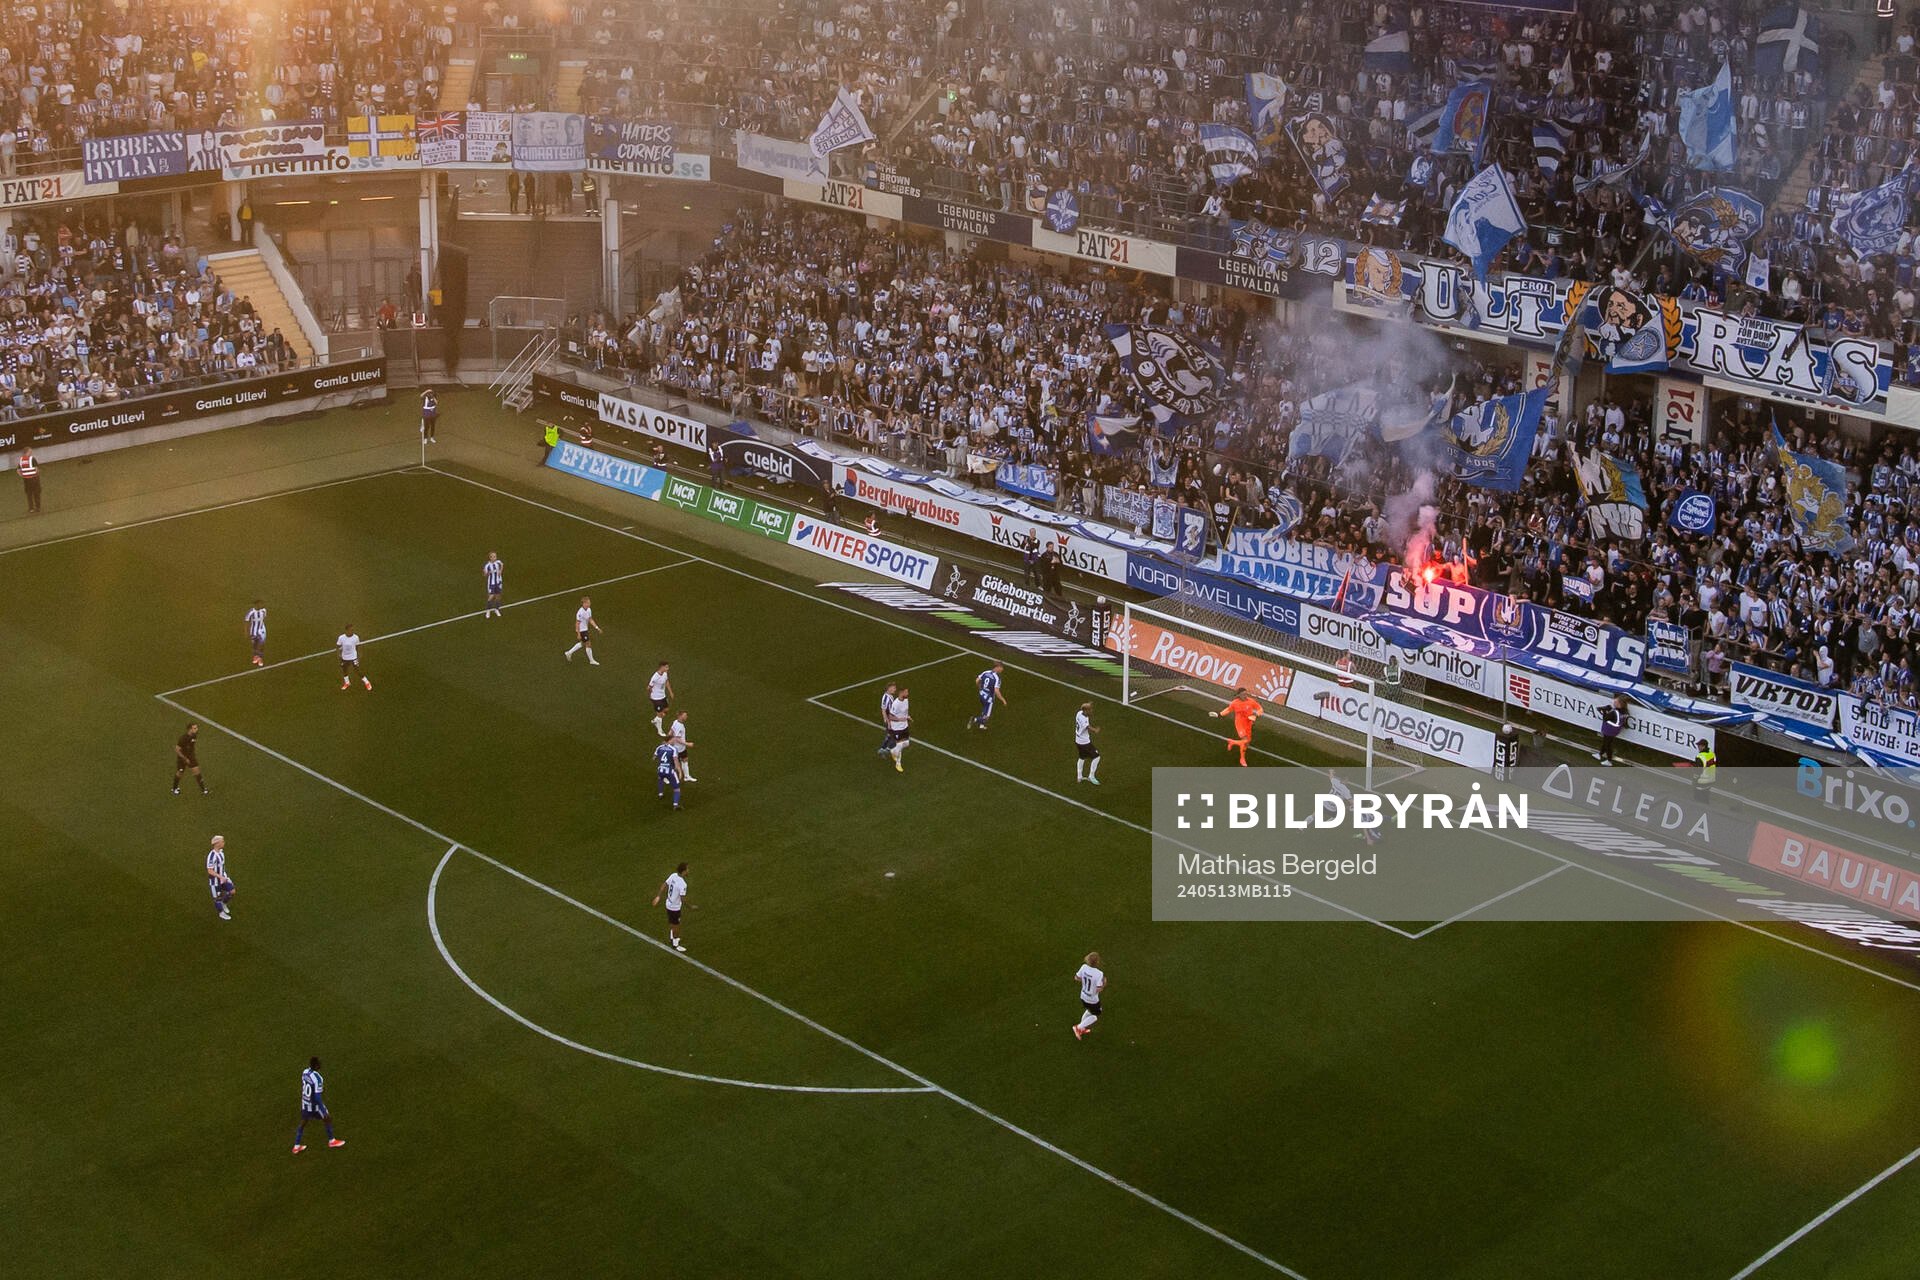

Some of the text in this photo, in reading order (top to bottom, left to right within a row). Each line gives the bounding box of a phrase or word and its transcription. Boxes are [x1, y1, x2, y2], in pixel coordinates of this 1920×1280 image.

[621, 122, 673, 143] HATERS
[85, 132, 183, 161] BEBBENS
[617, 143, 673, 162] CORNER
[879, 172, 911, 185] BROWN
[881, 165, 897, 175] THE
[4, 176, 64, 203] FAT21
[879, 182, 921, 198] BOMBERS
[937, 202, 996, 224] LEGENDENS
[943, 216, 989, 236] UTVALDA
[1077, 230, 1129, 264] FAT21
[1301, 239, 1342, 277] 12
[1225, 272, 1280, 295] UTVALDA
[1520, 279, 1550, 293] EROL
[1739, 318, 1772, 332] SYMPATI
[313, 367, 381, 390] Gamla Ullevi
[195, 396, 233, 411] Gamla
[235, 388, 267, 404] Ullevi
[560, 390, 585, 407] Gamla
[69, 417, 109, 435] Gamla
[111, 410, 145, 428] Ullevi
[601, 398, 706, 447] WASA OPTIK
[1666, 388, 1695, 441] T21
[0, 433, 16, 448] evi
[560, 443, 648, 488] EFFEKTIV
[743, 448, 794, 479] cuebid
[671, 483, 696, 502] MCR
[711, 494, 737, 516] MCR
[858, 481, 960, 527] Bergkvarabuss
[755, 510, 782, 530] MCR
[991, 524, 1028, 549] RAST
[811, 524, 931, 581] INTERSPORT
[1057, 544, 1110, 577] RASTA
[1226, 530, 1330, 571] OKTOBER
[980, 573, 1044, 606] Göteborgs
[972, 586, 1057, 626] Metallpartier
[1092, 609, 1101, 647] SELECT
[1308, 612, 1382, 649] granitor
[1151, 630, 1243, 688] Renova
[1349, 641, 1384, 659] ELECTRO
[1402, 648, 1482, 681] granitor
[983, 677, 990, 689] 9
[1446, 672, 1482, 691] ELECTRO
[1735, 673, 1833, 716] VIKTOR
[1533, 687, 1698, 750] STENFAGHETER
[1852, 725, 1920, 758] SWISH: 12
[660, 751, 668, 764] 4
[1494, 739, 1507, 782] SELECT
[1796, 757, 1917, 828] Brixo.
[1586, 777, 1711, 843] ELEDA
